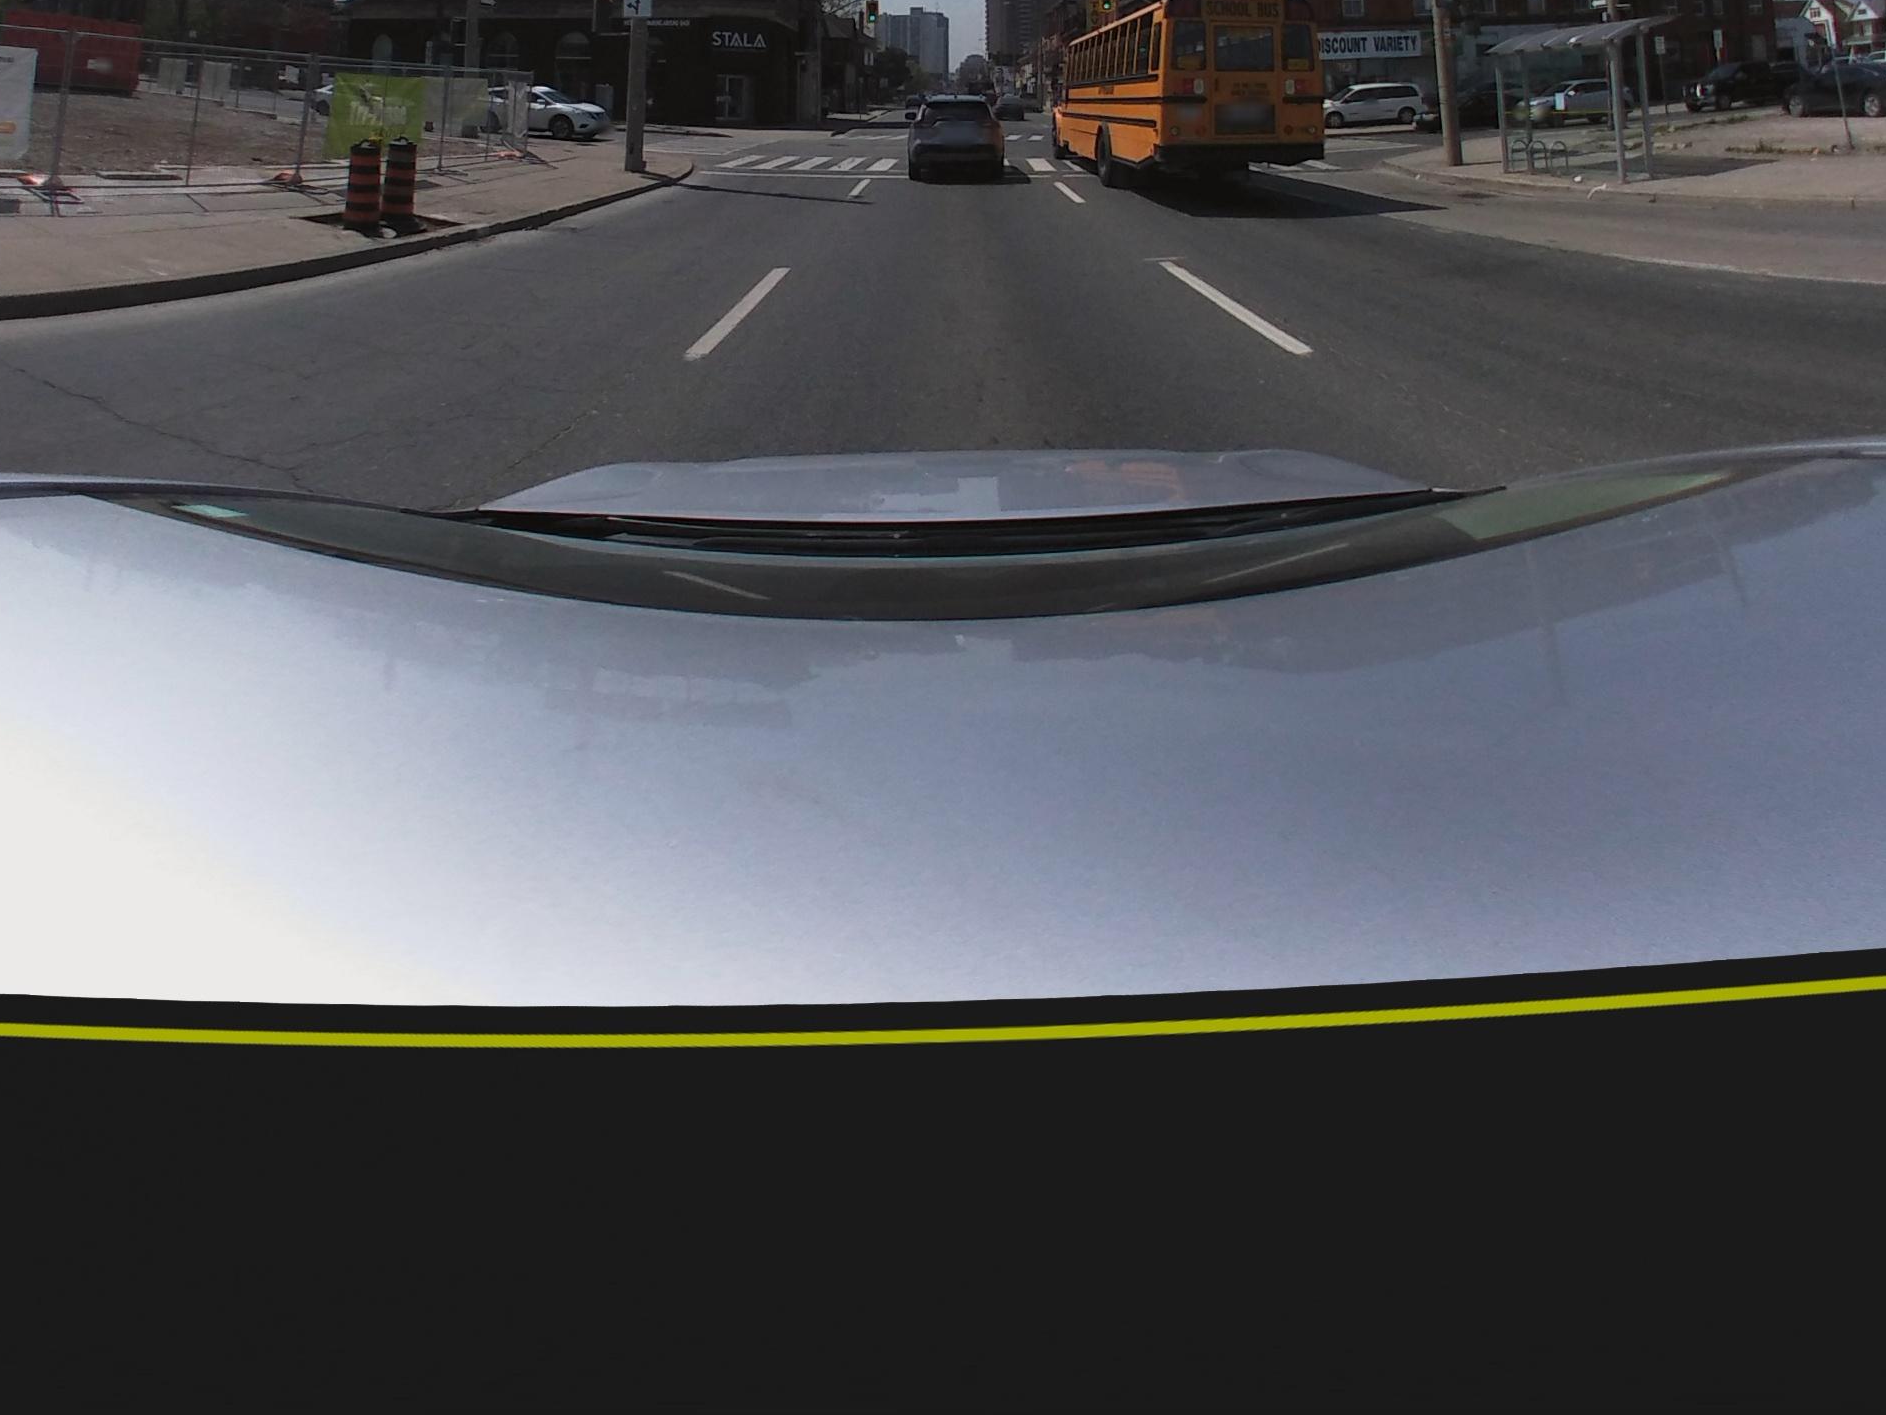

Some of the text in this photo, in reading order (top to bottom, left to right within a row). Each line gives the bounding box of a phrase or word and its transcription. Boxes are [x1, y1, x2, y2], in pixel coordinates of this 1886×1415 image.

[1206, 0, 1280, 17] SCHOOL BUS
[712, 31, 767, 48] STALA
[1373, 36, 1418, 52] VARIETY
